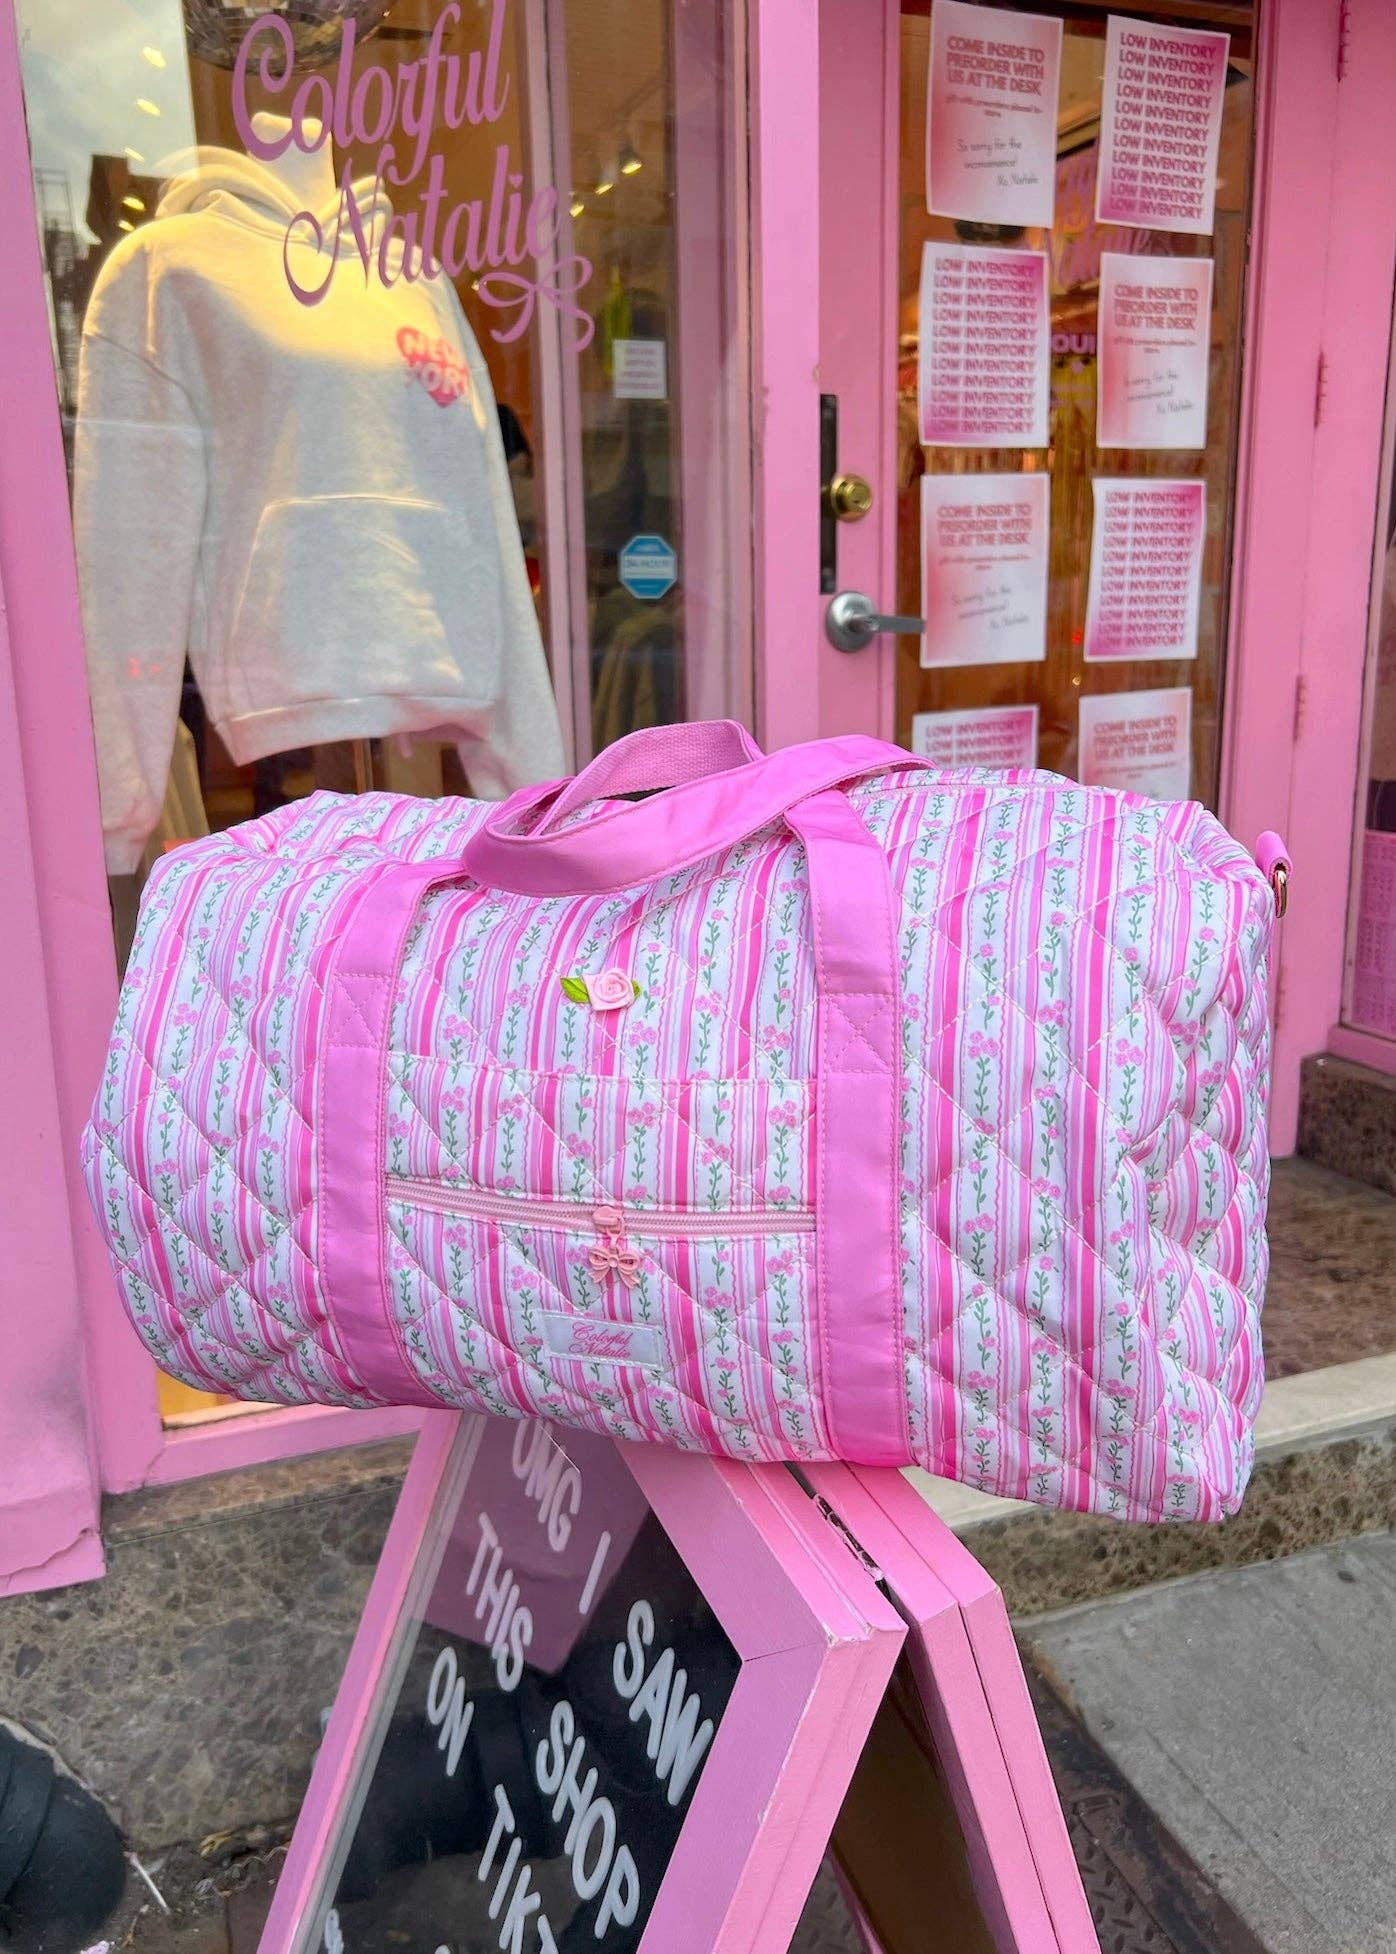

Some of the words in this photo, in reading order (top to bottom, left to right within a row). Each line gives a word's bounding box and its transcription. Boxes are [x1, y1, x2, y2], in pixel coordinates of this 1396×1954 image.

[947, 36, 984, 55] COME
[986, 41, 1025, 61] INSIDE
[1027, 48, 1045, 63] TO
[1121, 32, 1147, 49] LOW
[1149, 38, 1216, 58] INVENTORY
[946, 52, 1011, 74] PREORDER
[1013, 62, 1044, 79] WITH
[1119, 49, 1146, 65] LOW
[1148, 55, 1214, 76] INVENTORY
[948, 68, 964, 85] US
[967, 71, 983, 87] AT
[984, 73, 1008, 90] THE
[1010, 77, 1042, 96] DESK
[1118, 66, 1145, 82] LOW
[1147, 71, 1213, 92] INVENTORY
[232, 0, 511, 185] Colorful
[1117, 83, 1144, 99] LOW
[1146, 88, 1211, 108] INVENTORY
[1116, 100, 1143, 115] LOW
[1145, 105, 1210, 125] INVENTORY
[1114, 117, 1142, 133] LOW
[1144, 121, 1209, 141] INVENTORY
[1113, 133, 1141, 149] LOW
[1143, 138, 1207, 158] INVENTORY
[1112, 150, 1140, 165] LOW
[1142, 154, 1206, 174] INVENTORY
[1111, 166, 1139, 182] LOW
[1141, 170, 1205, 189] INVENTORY
[1111, 182, 1138, 197] LOW
[1140, 186, 1204, 204] INVENTORY
[1110, 197, 1137, 211] LOW
[1139, 201, 1202, 219] INVENTORY
[283, 144, 563, 307] Natalie
[935, 257, 962, 272] LOW
[967, 260, 1035, 277] INVENTORY
[934, 274, 961, 289] LOW
[967, 277, 1036, 293] INVENTORY
[933, 291, 961, 305] LOW
[966, 294, 1037, 309] INVENTORY
[1114, 284, 1143, 299] COME
[1148, 287, 1181, 300] INSIDE
[1183, 288, 1198, 301] TO
[1113, 298, 1167, 314] PREORDER
[1170, 303, 1198, 315] WITH
[932, 308, 960, 321] LOW
[966, 310, 1037, 324] INVENTORY
[1115, 313, 1128, 327] US
[1130, 315, 1144, 328] AT
[1145, 316, 1165, 328] THE
[1167, 317, 1196, 330] DESK
[932, 325, 960, 337] LOW
[966, 326, 1038, 341] INVENTORY
[931, 341, 960, 354] LOW
[966, 343, 1037, 357] INVENTORY
[931, 357, 959, 370] LOW
[965, 359, 1037, 373] INVENTORY
[931, 374, 959, 386] LOW
[965, 375, 1036, 389] INVENTORY
[931, 390, 959, 402] LOW
[964, 391, 1035, 404] INVENTORY
[931, 405, 958, 418] LOW
[963, 406, 1034, 420] INVENTORY
[931, 420, 958, 432] LOW
[962, 421, 1033, 434] INVENTORY
[1105, 490, 1130, 503] LOW
[1133, 491, 1194, 504] INVENTORY
[938, 505, 973, 517] COME
[976, 504, 1012, 517] INSIDE
[1015, 502, 1031, 516] TO
[1104, 505, 1129, 518] LOW
[1133, 506, 1194, 519] INVENTORY
[938, 519, 997, 533] PREORDER
[1002, 518, 1032, 530] WITH
[1104, 520, 1128, 533] LOW
[1132, 521, 1193, 533] INVENTORY
[941, 534, 956, 547] US
[959, 533, 974, 547] AT
[976, 533, 997, 546] THE
[999, 532, 1031, 545] DESK
[1103, 535, 1128, 547] LOW
[1131, 535, 1193, 548] INVENTORY
[1103, 550, 1127, 562] LOW
[1131, 550, 1192, 562] INVENTORY
[1102, 565, 1125, 577] LOW
[1130, 565, 1191, 577] INVENTORY
[1102, 580, 1124, 592] LOW
[1128, 580, 1189, 592] INVENTORY
[1101, 594, 1123, 606] LOW
[1127, 594, 1187, 606] INVENTORY
[1100, 609, 1122, 621] LOW
[1126, 609, 1186, 621] INVENTORY
[1099, 623, 1122, 635] LOW
[1125, 623, 1185, 634] INVENTORY
[1098, 637, 1122, 649] LOW
[1125, 636, 1184, 648] INVENTORY
[926, 725, 953, 738] LOW
[957, 719, 1024, 734] INVENTORY
[1094, 722, 1125, 734] COME
[1128, 719, 1161, 730] INSIDE
[1162, 715, 1177, 727] TO
[926, 739, 953, 752] LOW
[957, 734, 1023, 748] INVENTORY
[1093, 733, 1149, 746] PREORDER
[1151, 730, 1176, 740] WITH
[957, 748, 1023, 763] INVENTORY
[1095, 747, 1109, 760] US
[1111, 746, 1125, 758] AT
[1127, 746, 1147, 757] THE
[1149, 743, 1174, 754] DESK
[572, 1322, 634, 1349] Colorful
[569, 1342, 631, 1358] Natalie
[579, 1530, 612, 1615] I
[613, 1600, 715, 1806] SAW
[427, 1646, 475, 1777] ON
[466, 1512, 533, 1692] THIS
[535, 1701, 640, 1939] SHOP
